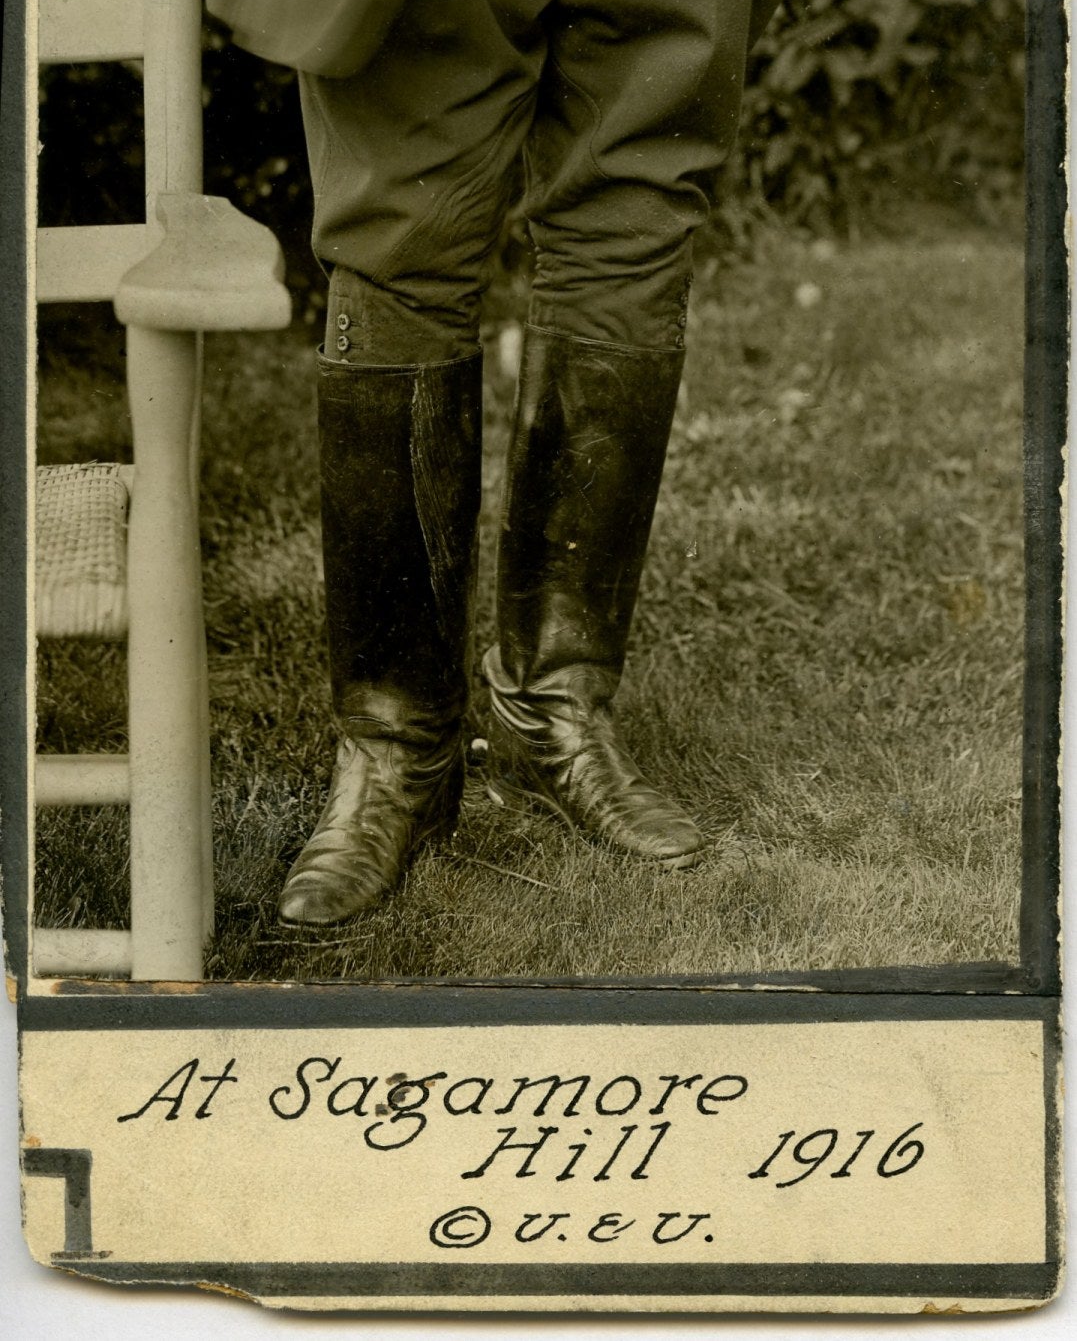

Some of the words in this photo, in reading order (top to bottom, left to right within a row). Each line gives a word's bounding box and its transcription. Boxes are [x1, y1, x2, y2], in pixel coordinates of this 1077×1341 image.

[116, 1056, 238, 1123] At
[268, 1056, 749, 1152] Sagamore
[460, 1121, 672, 1184] Hill
[747, 1122, 925, 1189] 1916
